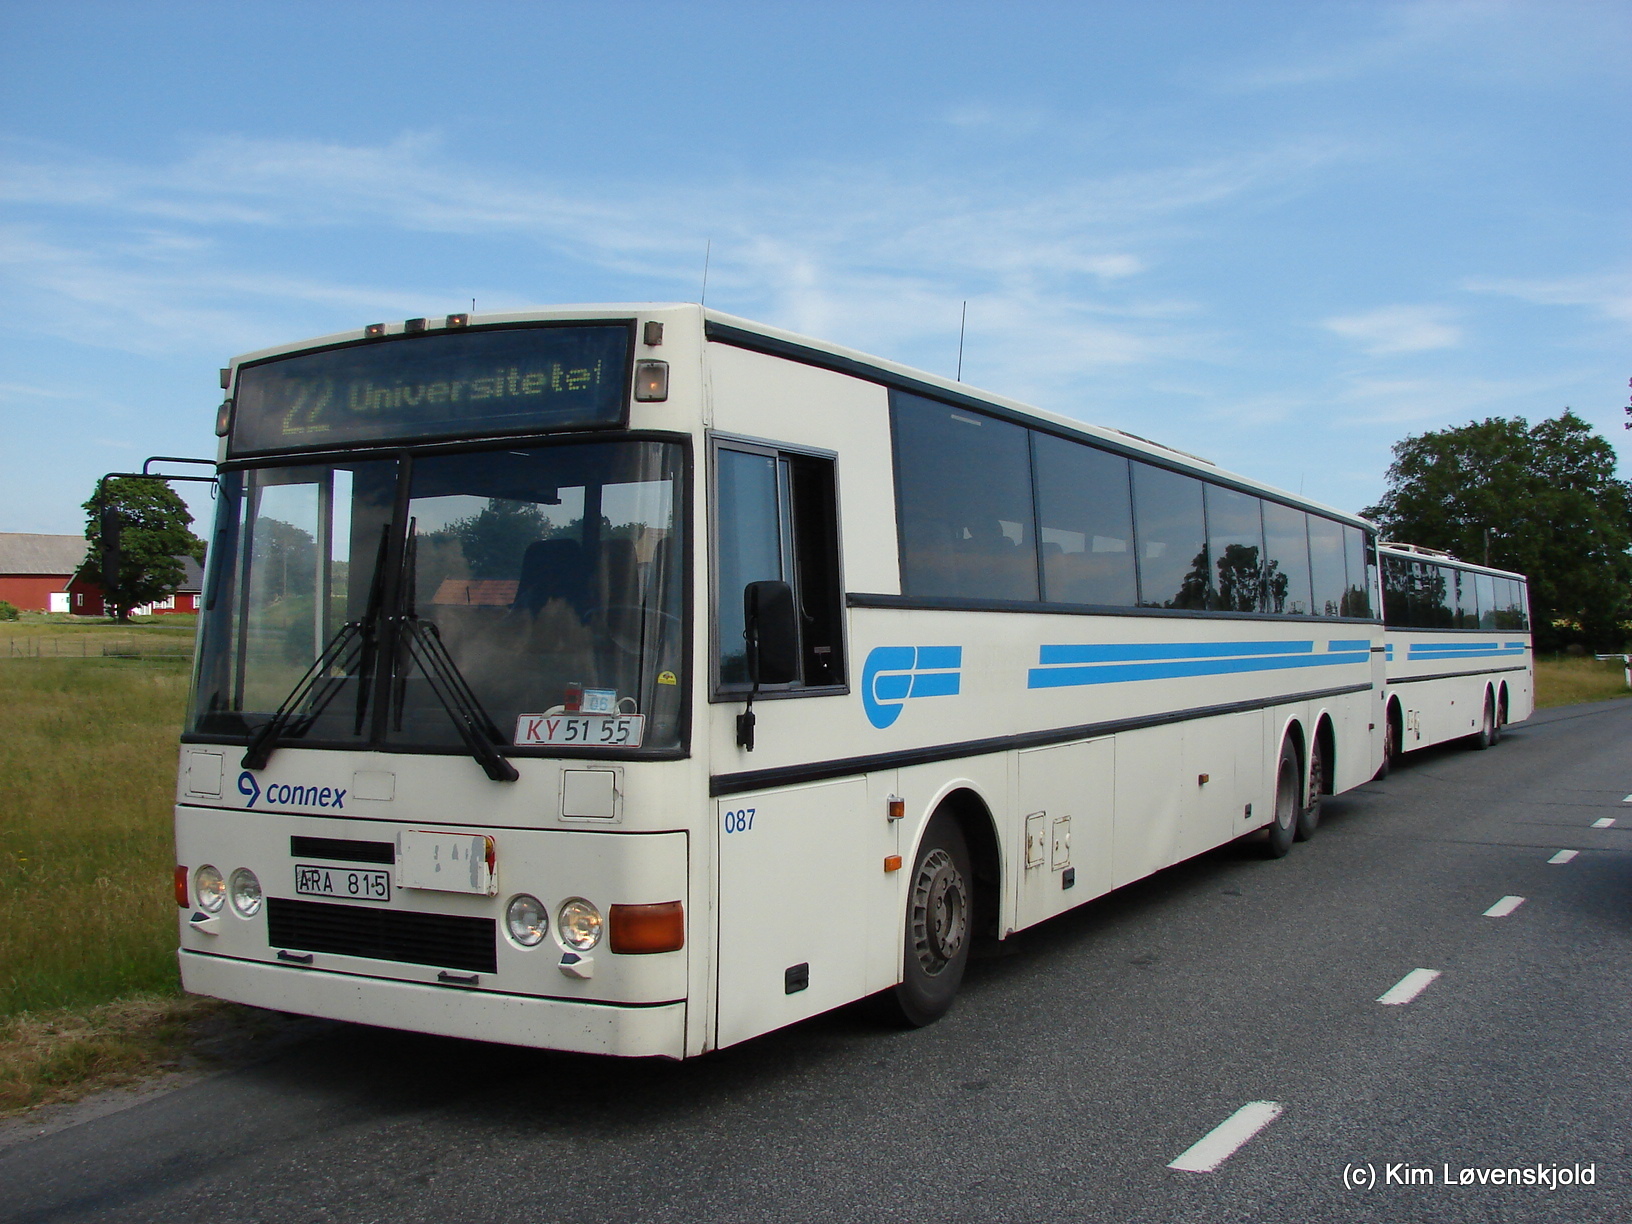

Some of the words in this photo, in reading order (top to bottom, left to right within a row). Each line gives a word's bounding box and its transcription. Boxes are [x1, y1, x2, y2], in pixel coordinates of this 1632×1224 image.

[282, 381, 333, 435] 22
[526, 719, 561, 741] KY
[564, 719, 589, 742] 51
[600, 720, 630, 742] 55
[266, 783, 347, 808] connex
[724, 808, 756, 834] 087
[299, 869, 333, 893] ARA
[347, 873, 386, 897] 815
